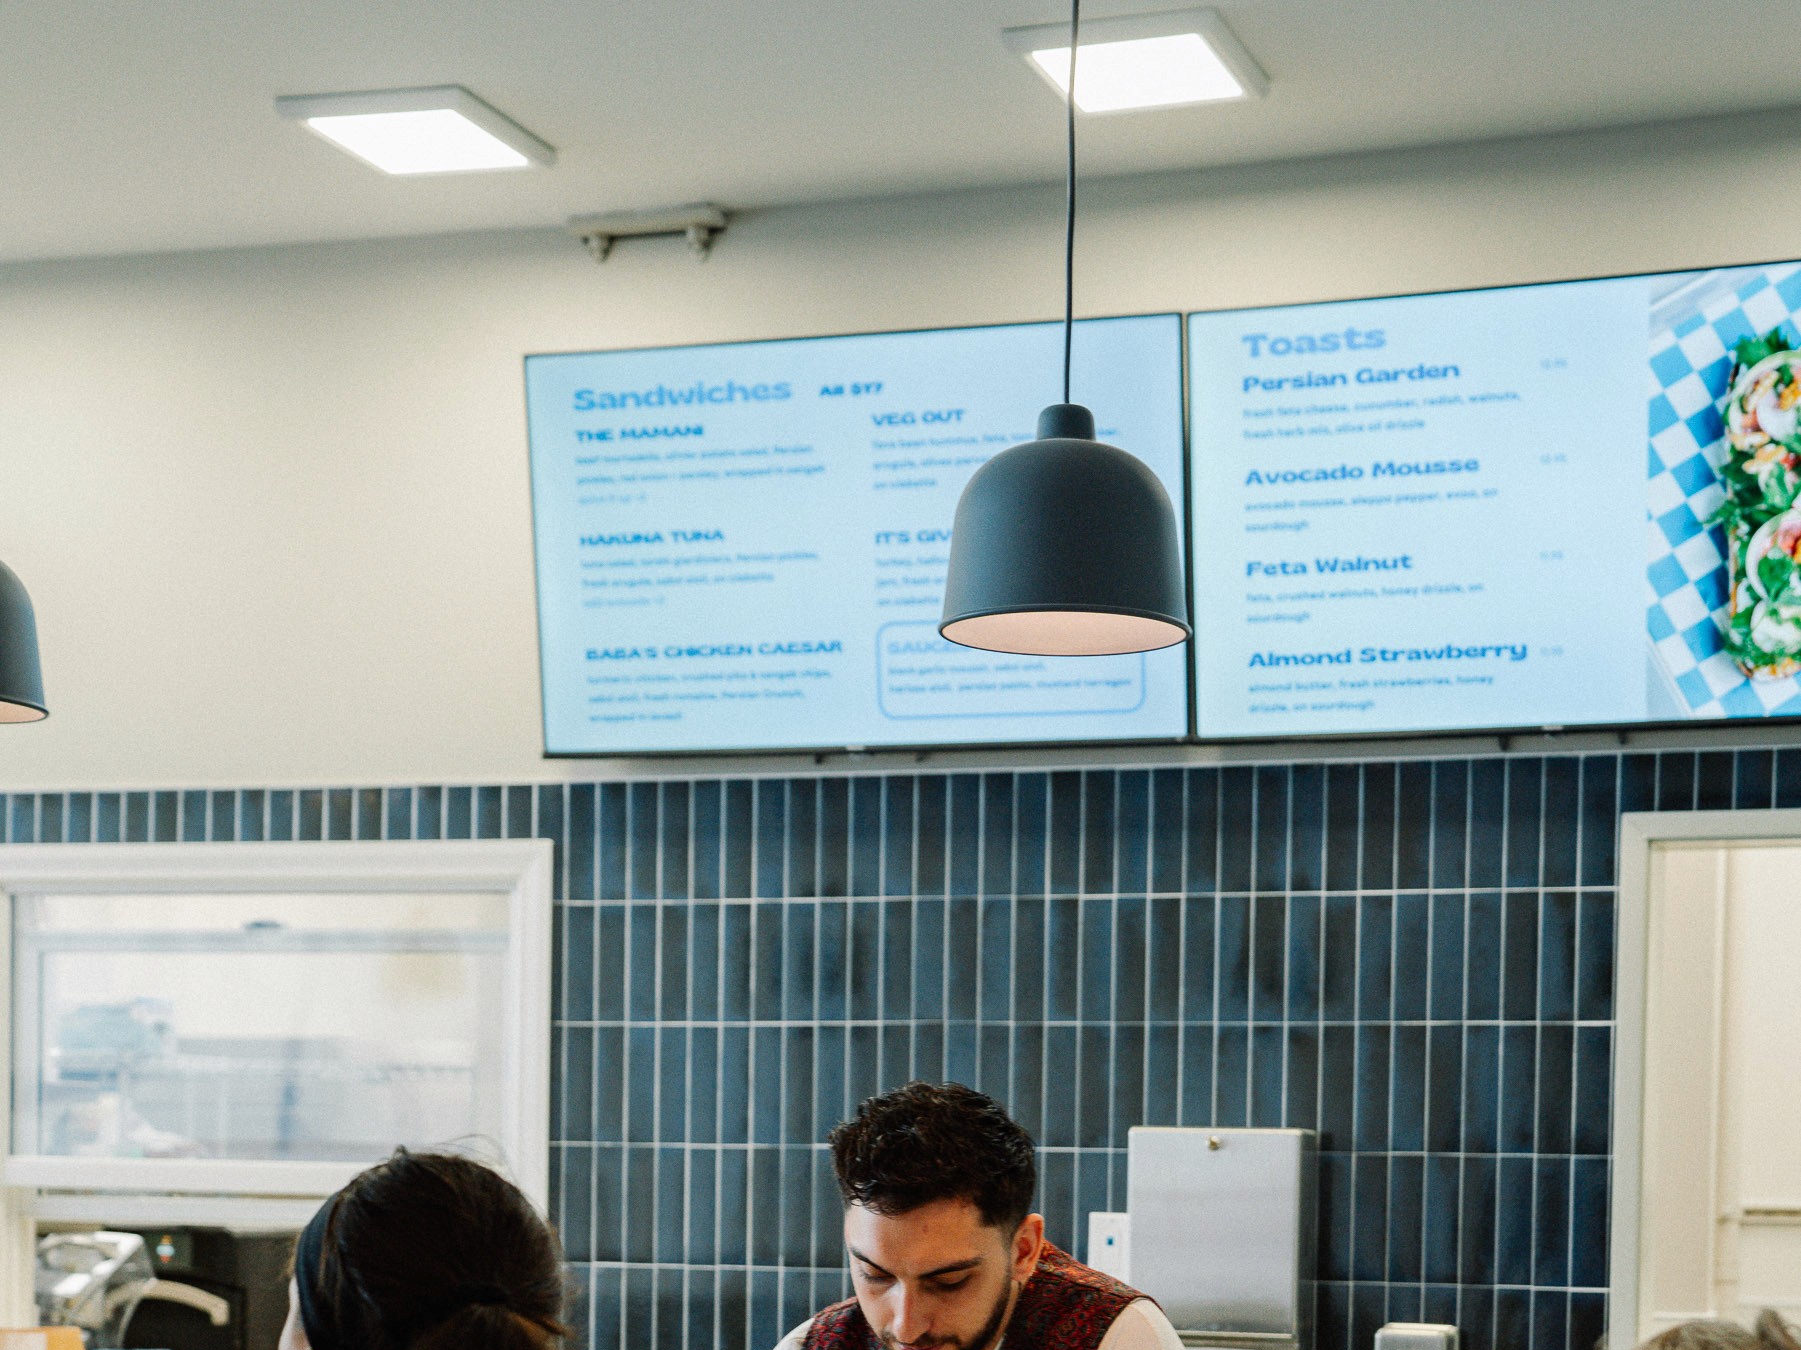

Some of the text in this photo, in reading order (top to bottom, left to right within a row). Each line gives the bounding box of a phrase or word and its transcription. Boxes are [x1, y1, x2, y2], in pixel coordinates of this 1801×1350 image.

[1242, 327, 1386, 358] Toasts
[1242, 363, 1460, 393] Persian Garden
[574, 381, 791, 411] Sandwiches
[872, 409, 964, 427] VEG OUT
[577, 430, 614, 442] THE
[1245, 457, 1479, 485] Avocado Mousse
[671, 529, 724, 543] TUNA
[917, 529, 952, 542] GIV
[1246, 554, 1412, 577] Feta Walnut
[664, 644, 752, 658] CHICKEN
[759, 640, 842, 655] CAESAR
[1249, 648, 1351, 667] Almond
[1360, 642, 1528, 662] Strawberry
